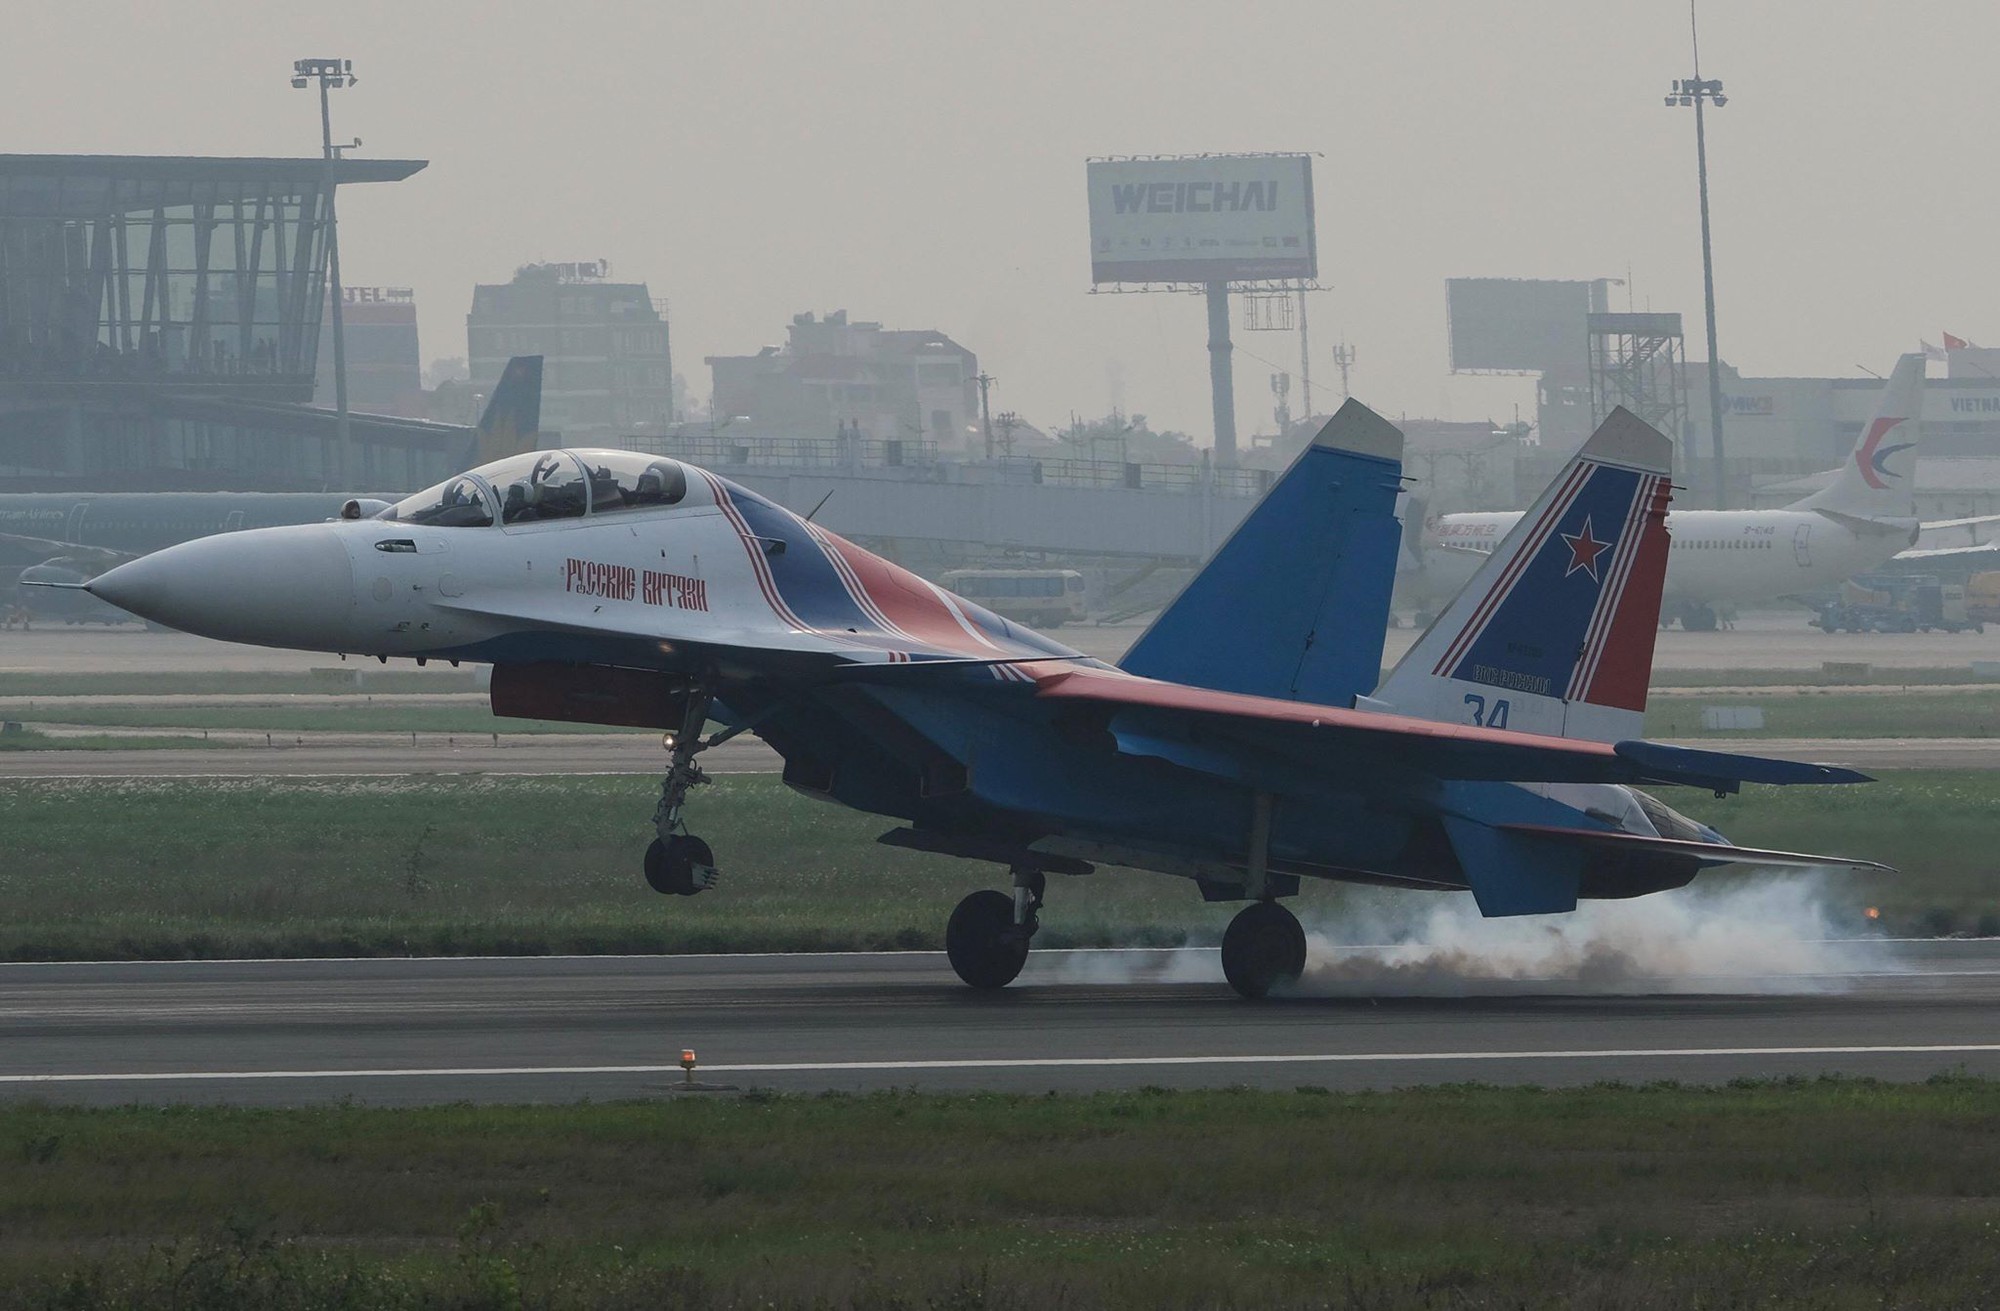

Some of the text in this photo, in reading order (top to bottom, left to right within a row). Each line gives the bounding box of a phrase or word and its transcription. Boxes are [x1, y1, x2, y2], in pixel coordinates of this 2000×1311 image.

[1111, 180, 1279, 214] WEICHAI
[565, 557, 709, 612] РУССКИЕ ВИТЯЗИ
[1464, 693, 1510, 730] 34
